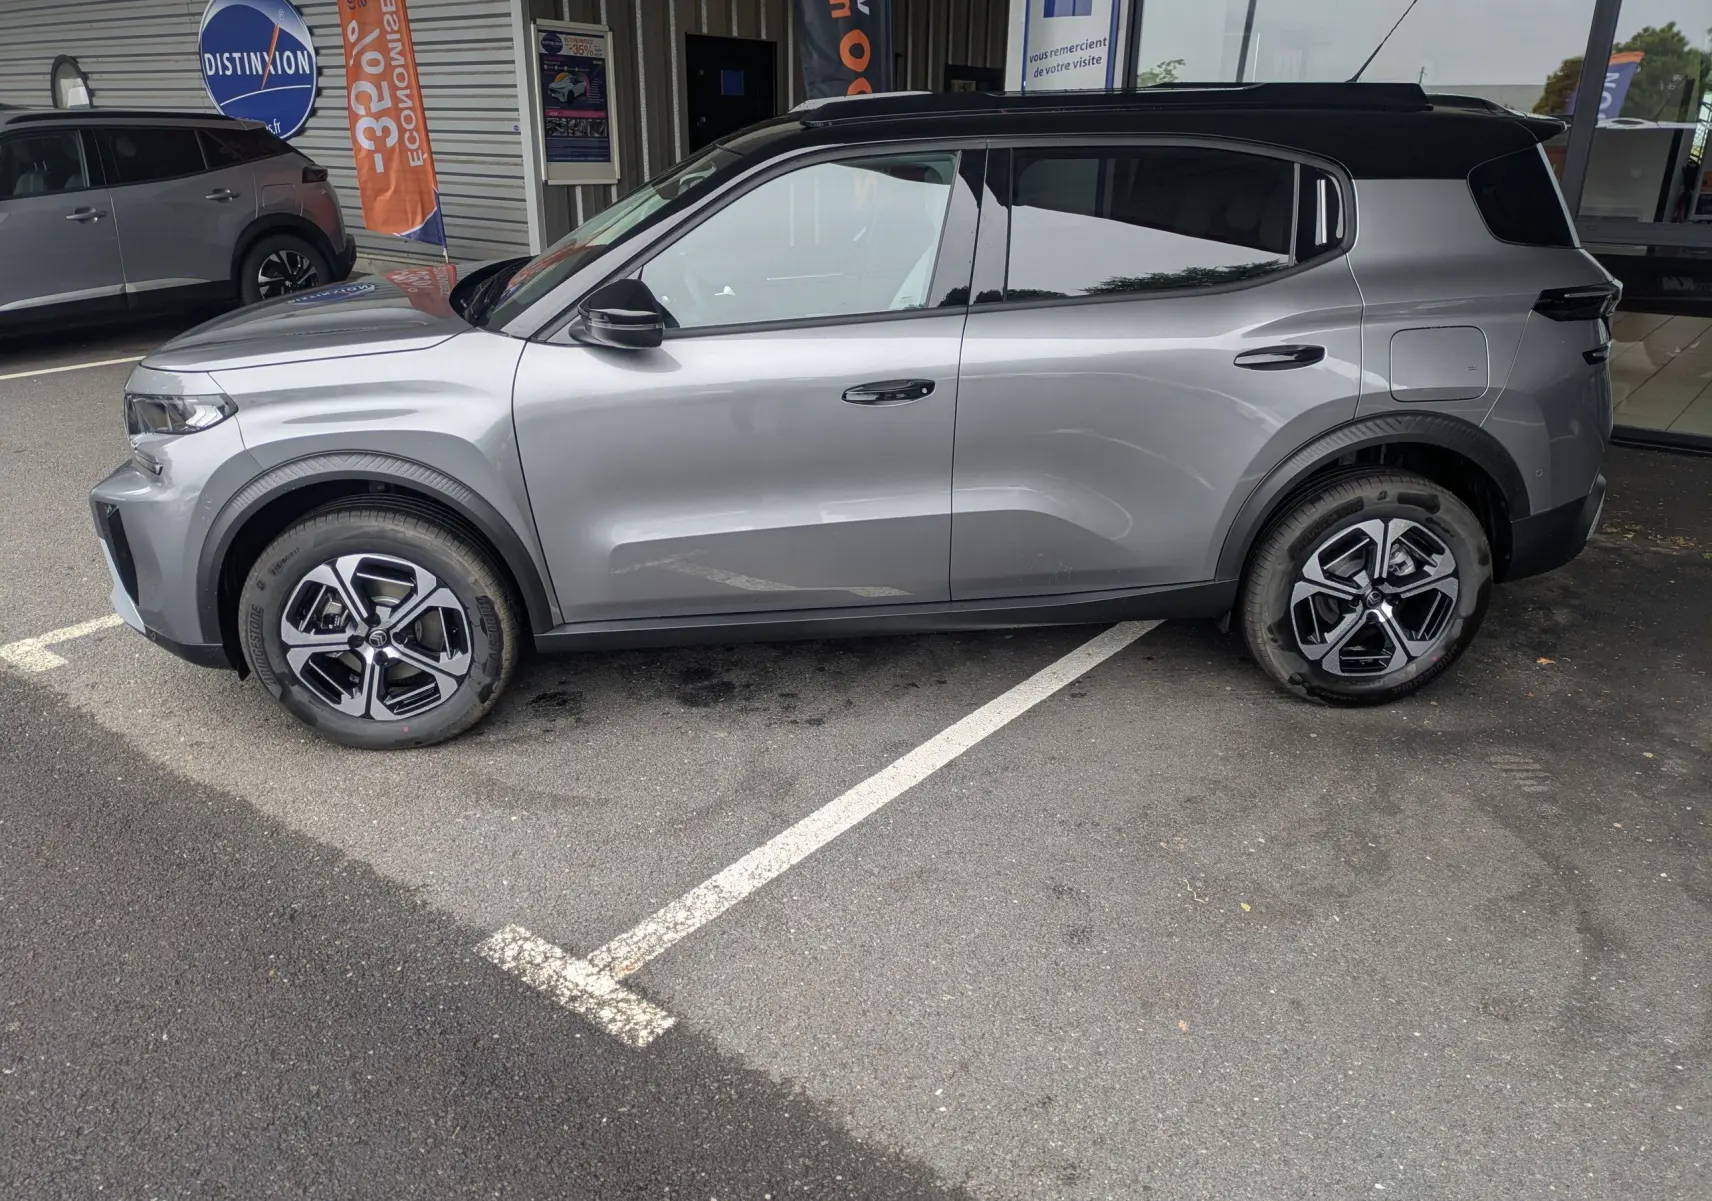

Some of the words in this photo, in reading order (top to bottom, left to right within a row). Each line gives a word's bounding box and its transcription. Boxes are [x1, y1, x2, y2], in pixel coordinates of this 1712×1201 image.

[204, 50, 310, 76] DISTINXION
[1029, 49, 1048, 63] vous
[1050, 37, 1107, 58] remercient
[1034, 66, 1044, 78] de
[1045, 61, 1071, 75] votre
[1072, 55, 1102, 69] visite
